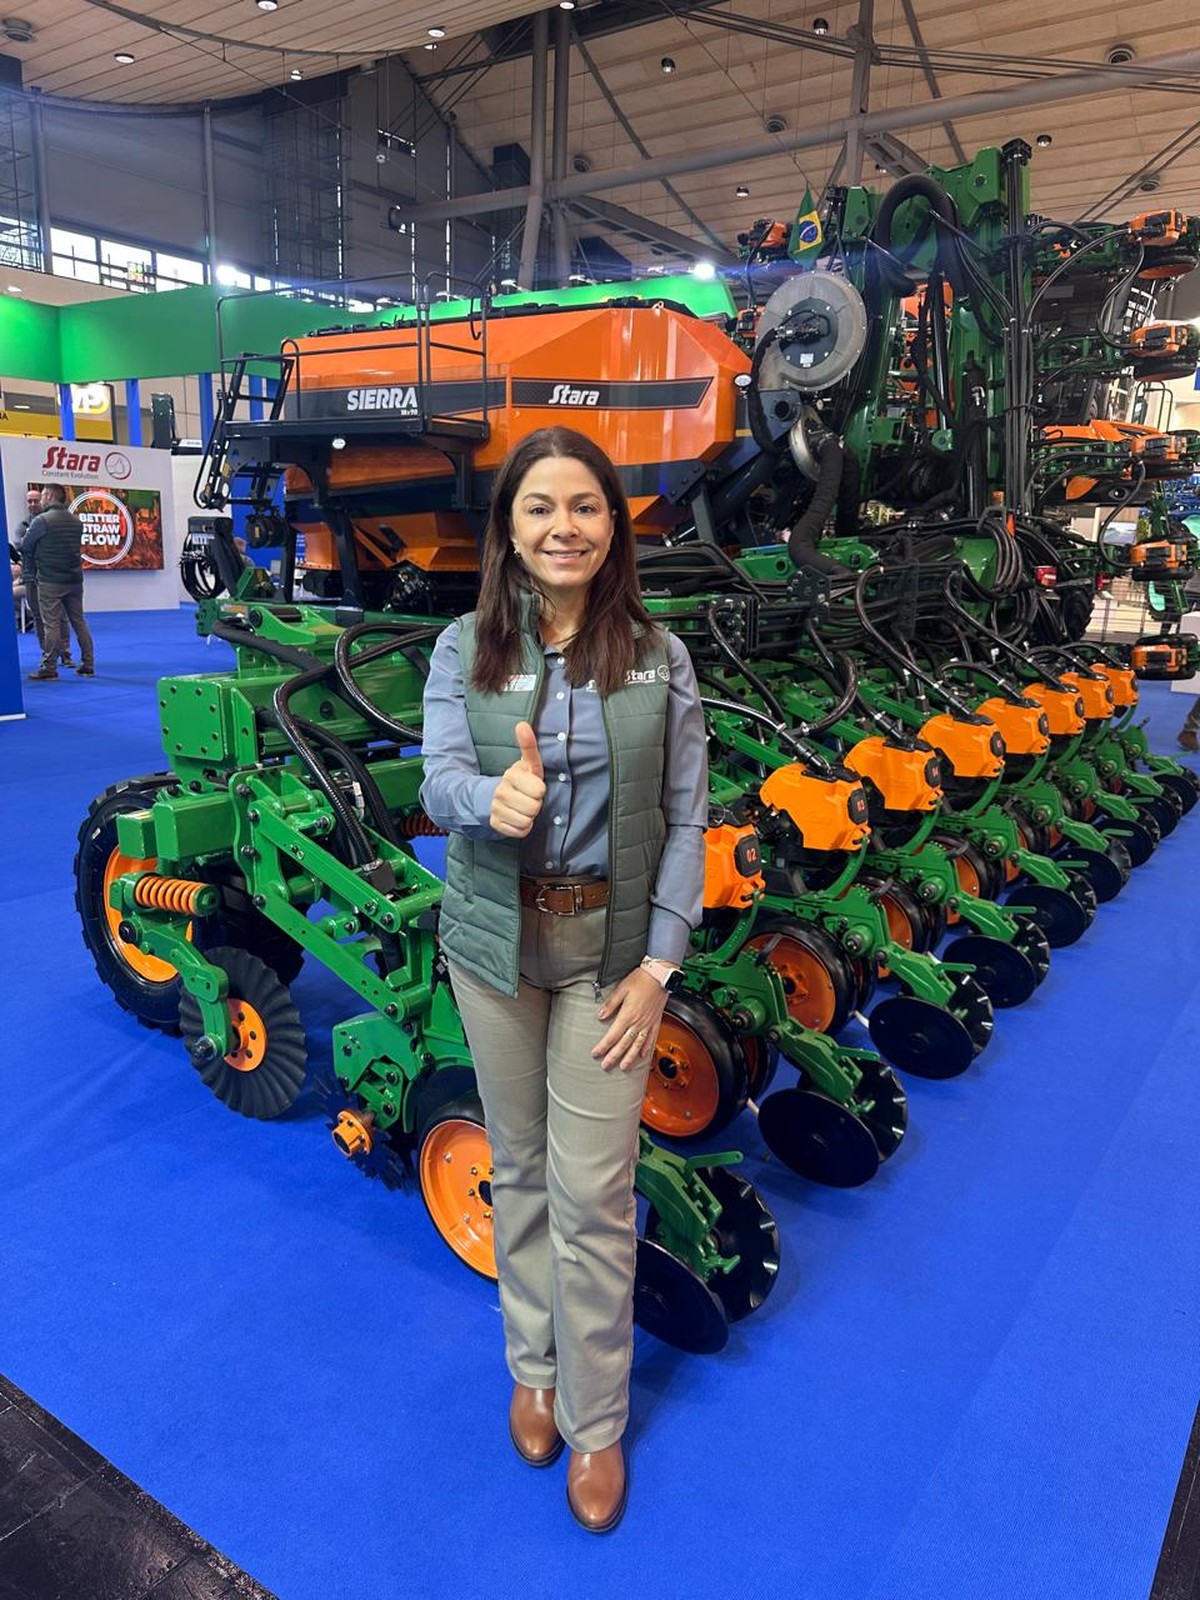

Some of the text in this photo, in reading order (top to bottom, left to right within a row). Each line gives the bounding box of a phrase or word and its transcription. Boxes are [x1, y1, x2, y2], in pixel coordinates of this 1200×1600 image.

[347, 387, 418, 411] SIERRA
[548, 384, 600, 406] Stara
[42, 446, 101, 472] Stara
[42, 470, 69, 478] Constant
[79, 513, 120, 523] BETTER
[81, 534, 121, 545] FLOW
[746, 848, 757, 862] 02
